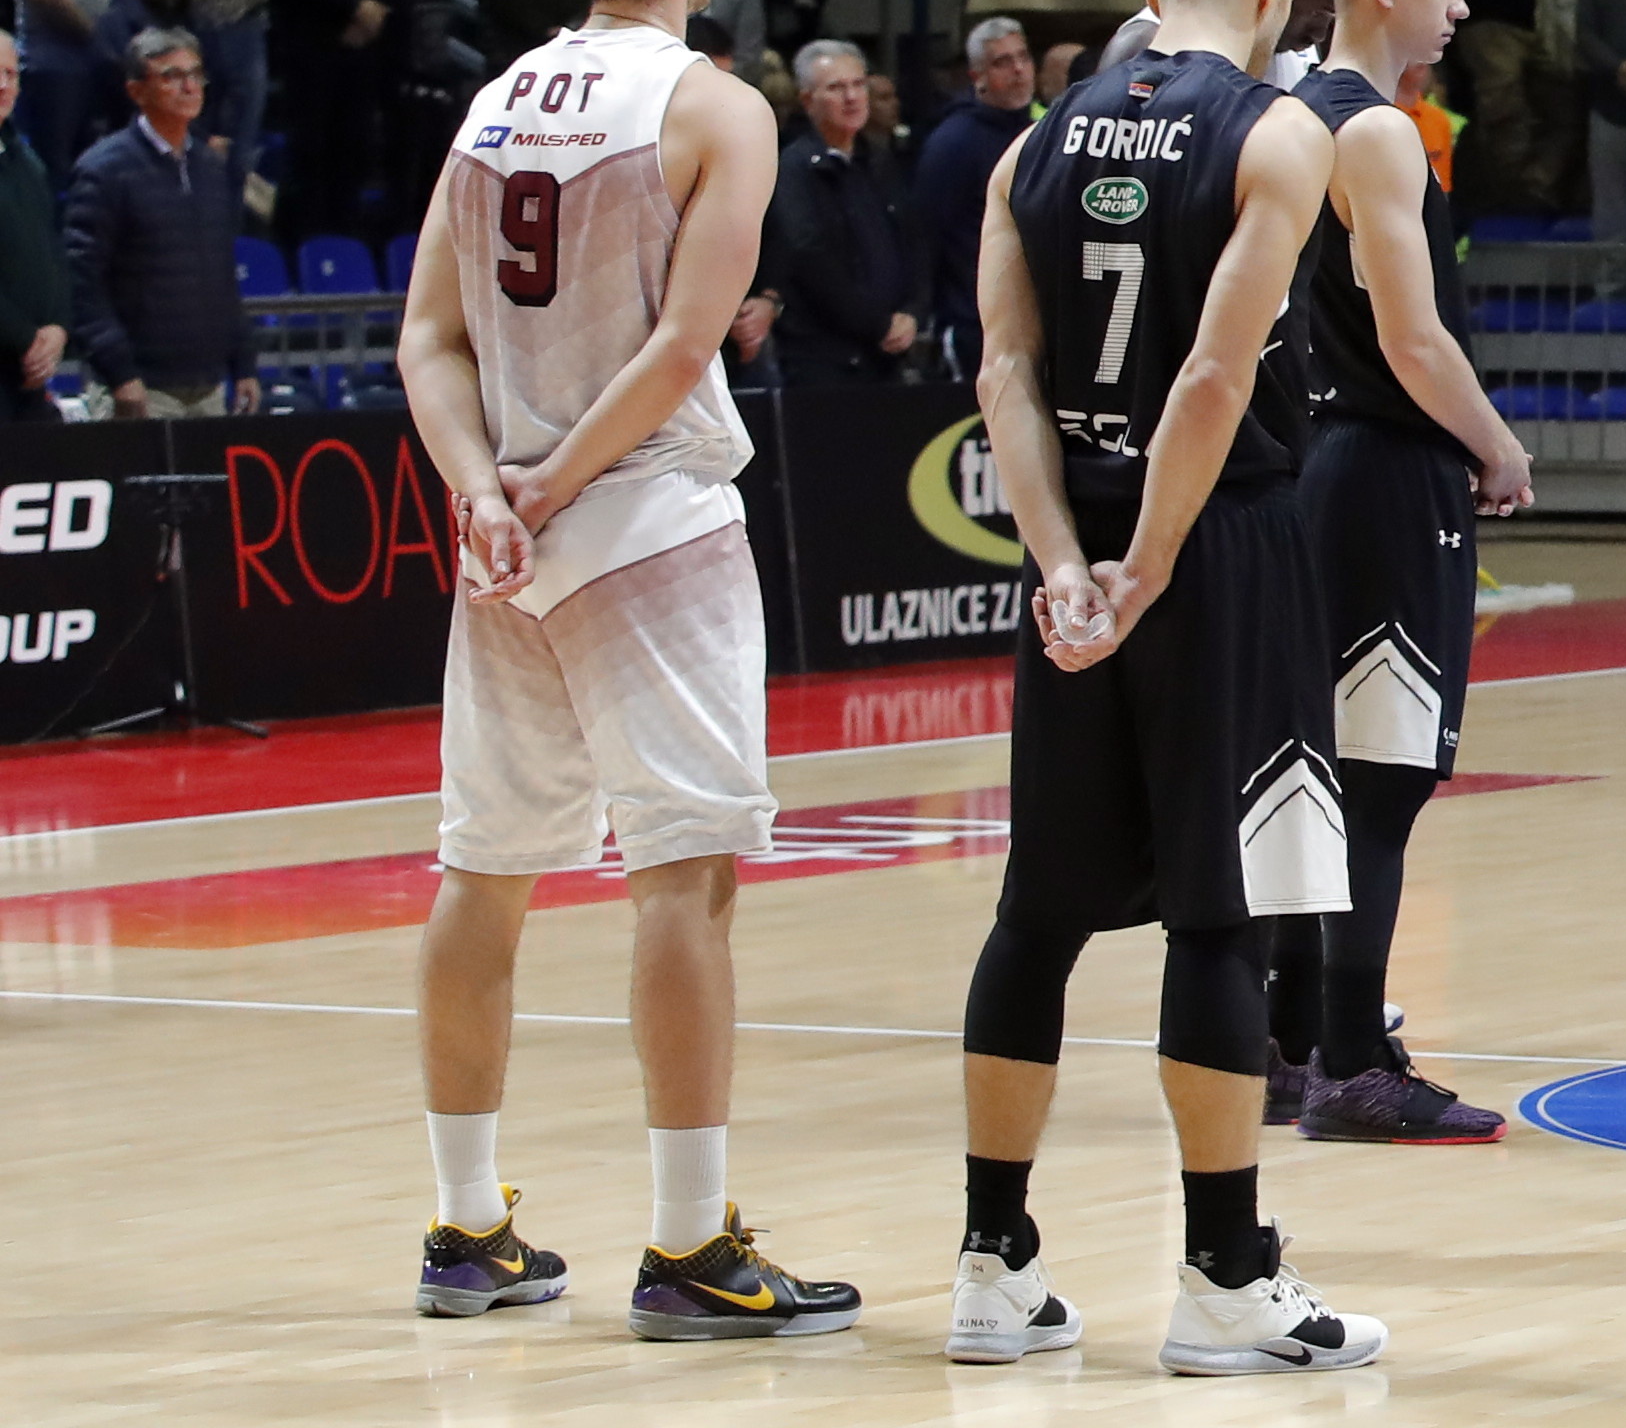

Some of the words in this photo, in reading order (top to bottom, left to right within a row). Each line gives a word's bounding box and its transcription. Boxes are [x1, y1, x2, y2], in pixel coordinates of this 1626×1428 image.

[504, 71, 605, 114] POT
[511, 133, 607, 147] MILSPED
[1062, 113, 1195, 162] GORDIĆ
[497, 170, 561, 308] 9
[1082, 241, 1146, 384] 7
[225, 434, 460, 609] ROA
[0, 608, 97, 665] UP
[840, 582, 987, 646] ULAZNICE
